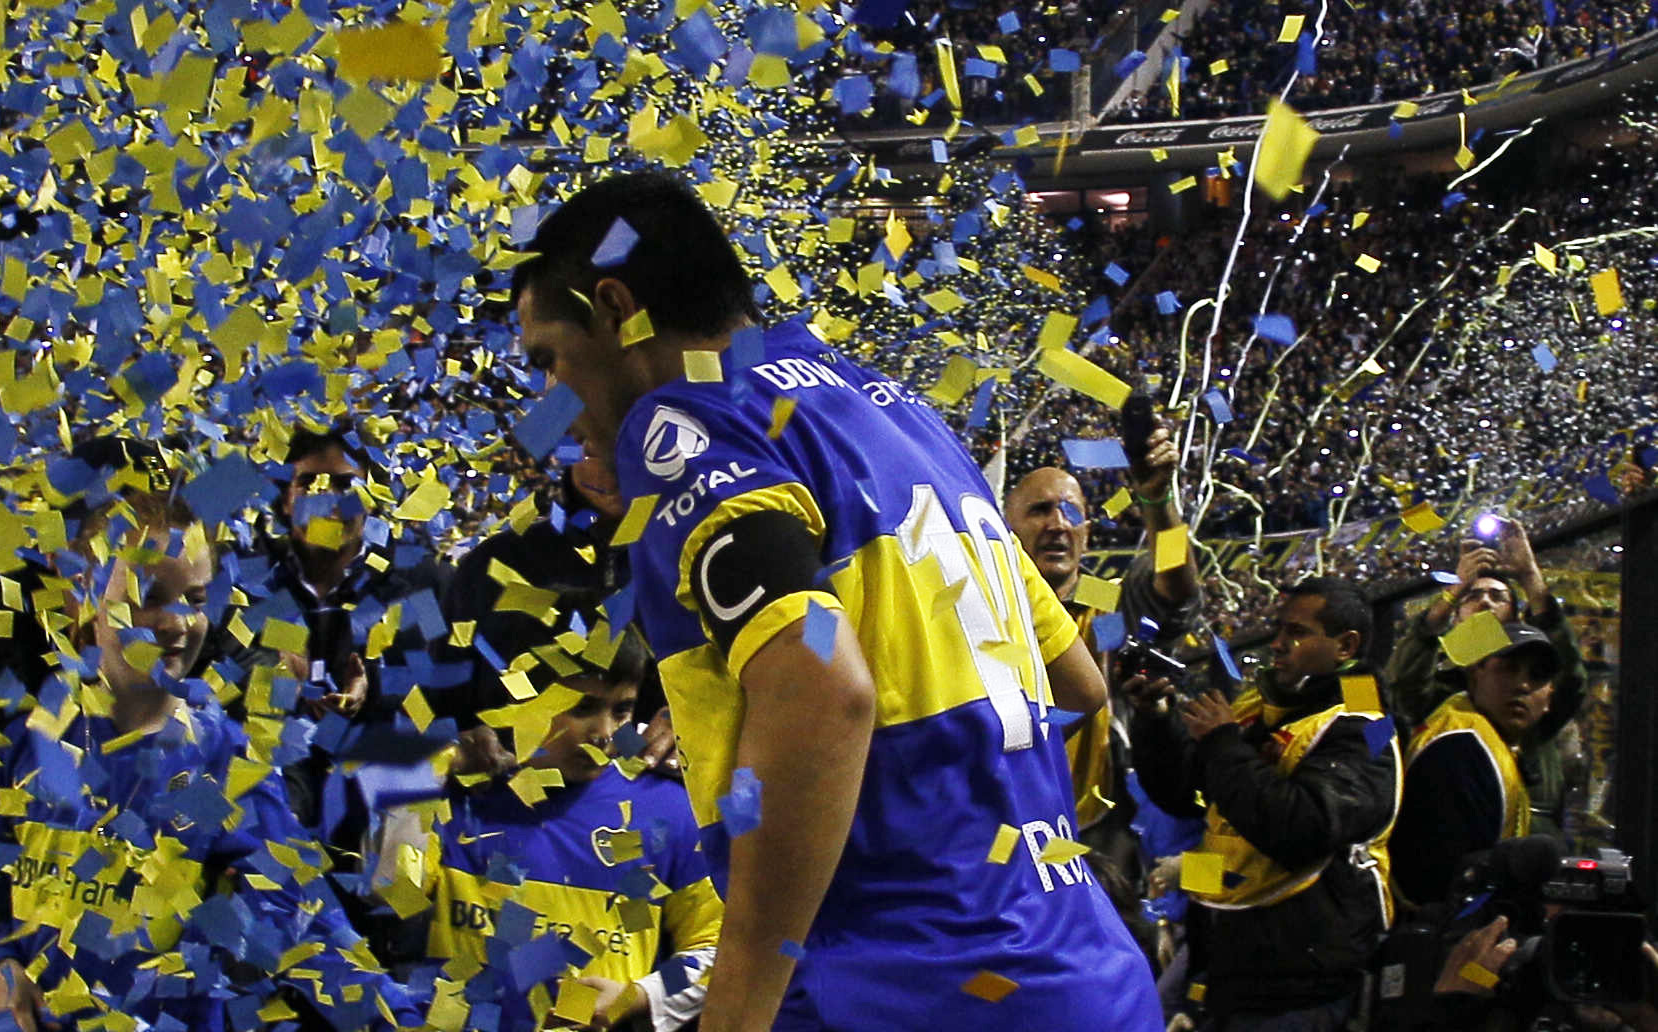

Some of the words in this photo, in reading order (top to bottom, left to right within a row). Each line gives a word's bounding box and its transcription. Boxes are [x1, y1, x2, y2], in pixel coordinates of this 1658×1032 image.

[656, 461, 758, 527] TOTAL
[700, 532, 766, 622] C
[894, 483, 1051, 753] 10
